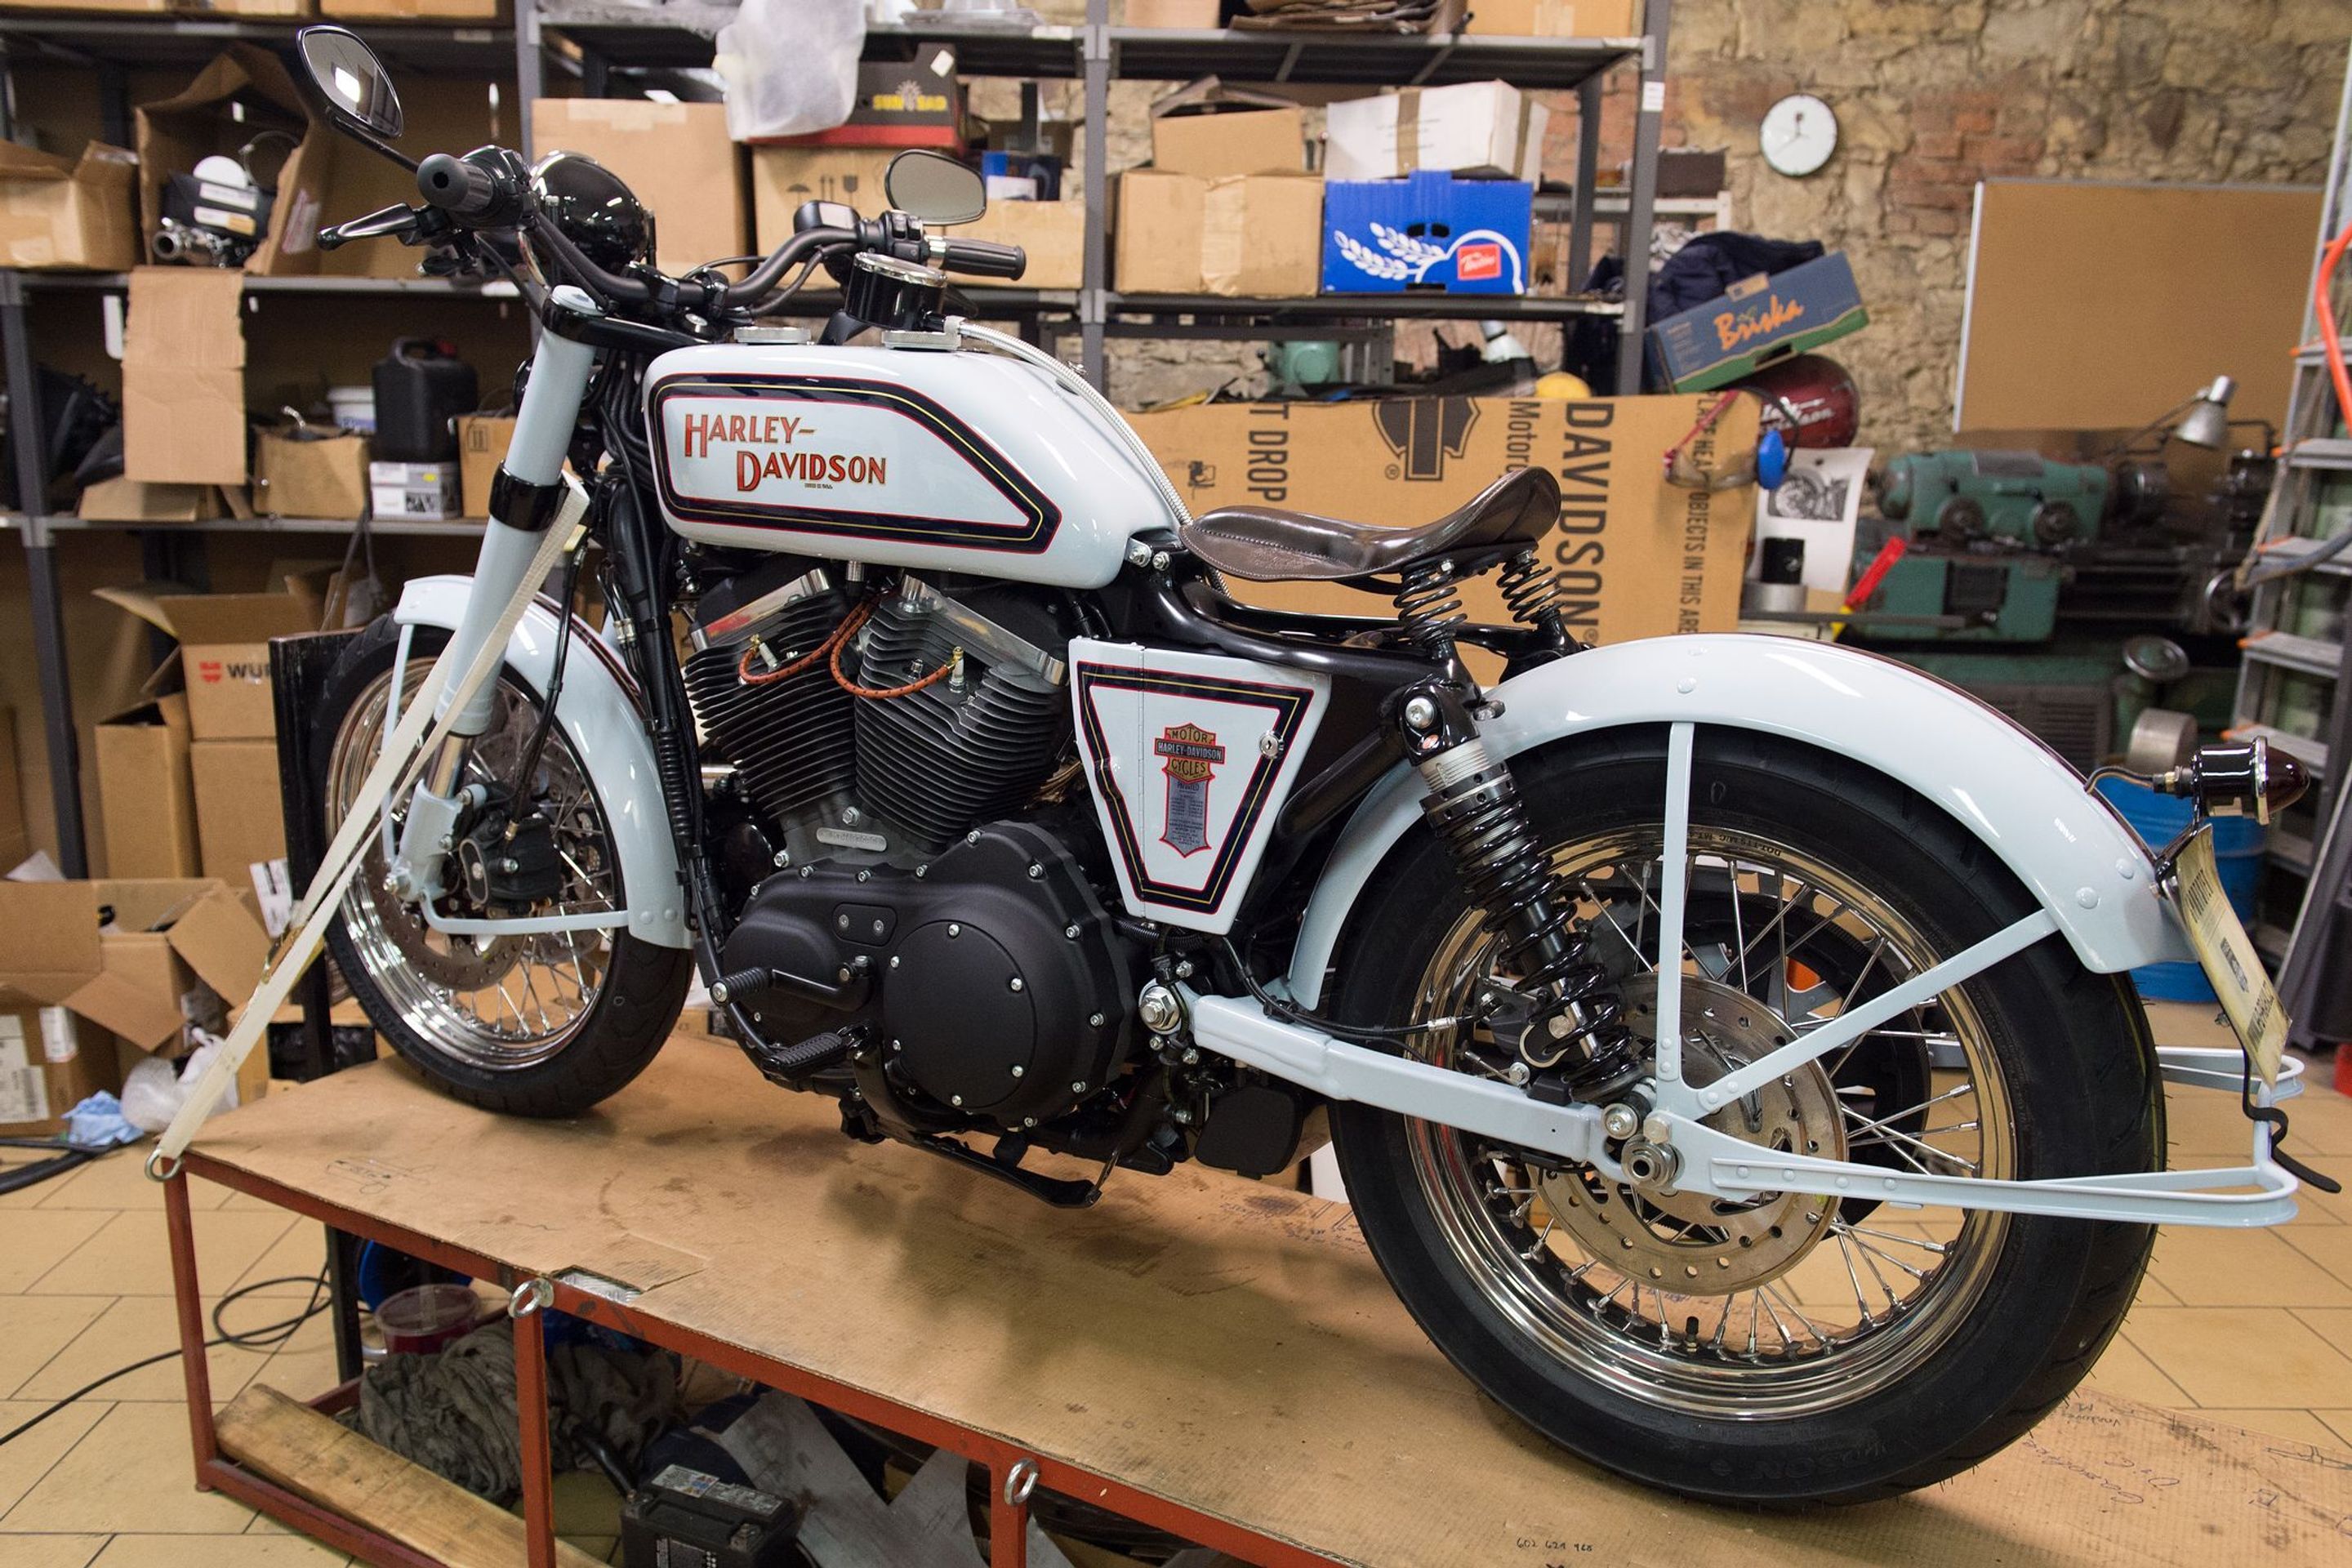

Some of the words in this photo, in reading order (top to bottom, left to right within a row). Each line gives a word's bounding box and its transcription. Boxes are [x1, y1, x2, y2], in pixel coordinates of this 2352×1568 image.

[737, 450, 887, 492] DAVIDSON
[1247, 430, 1289, 502] DROP
[1555, 403, 1615, 627] DAVIDSON
[1685, 492, 1711, 552] OBJECTS
[1683, 557, 1704, 572] IN
[1680, 575, 1704, 606] THIS
[1171, 726, 1208, 743] MOTOR
[1158, 742, 1222, 760] HARLEY-DAVIDSON
[1171, 758, 1206, 776] CYCLES
